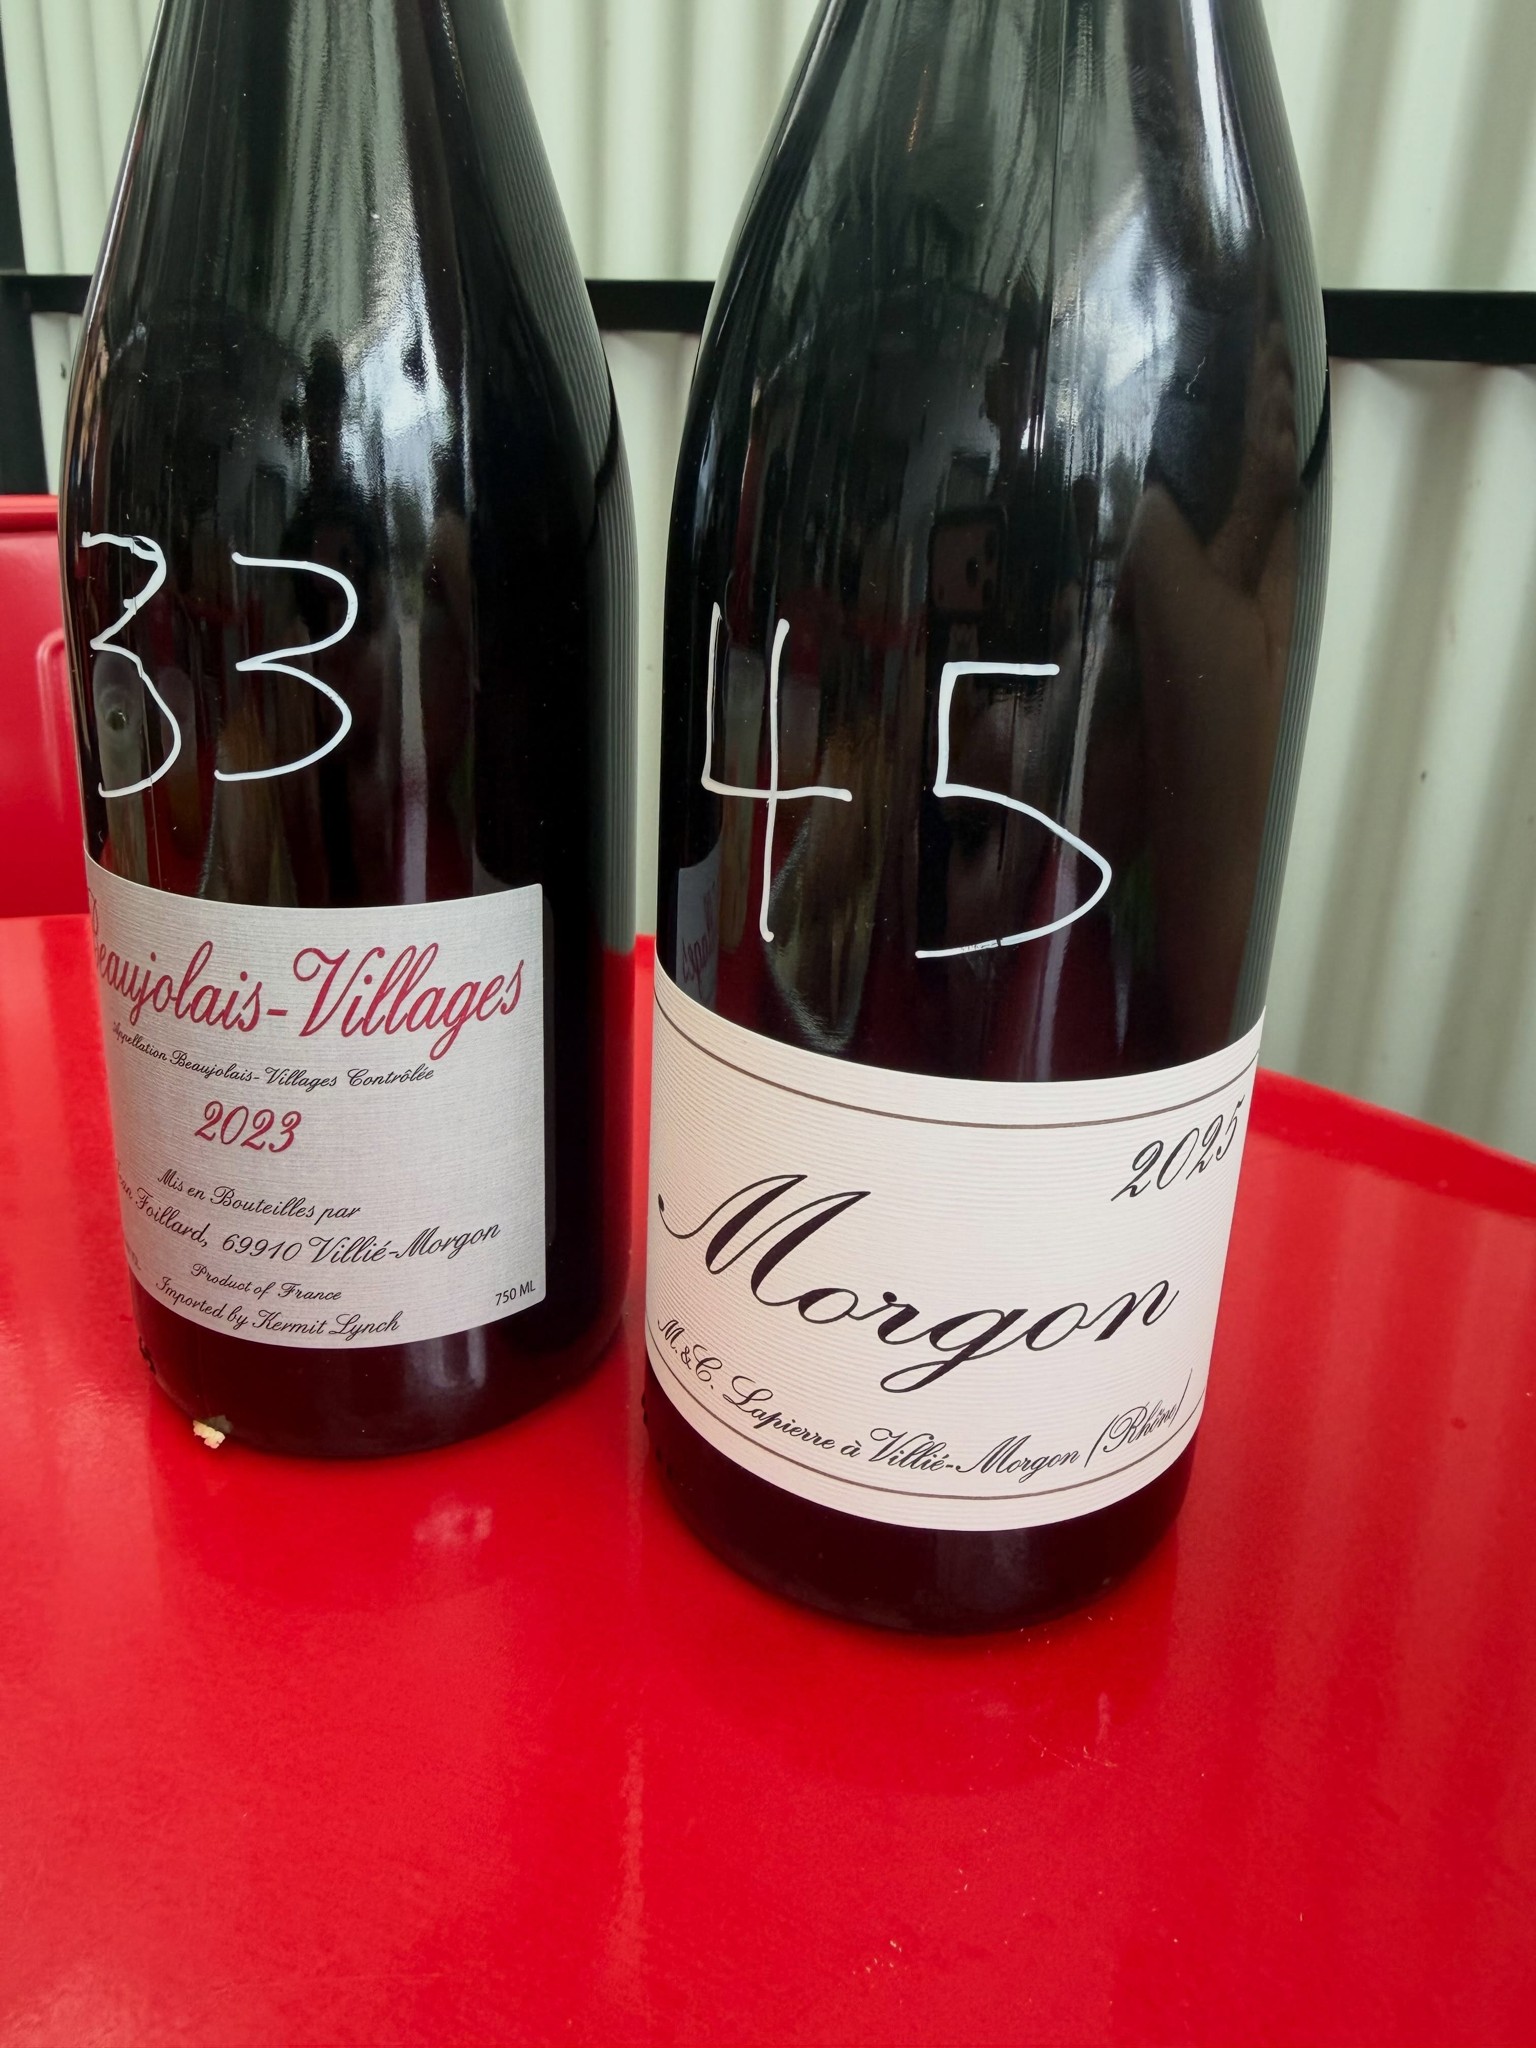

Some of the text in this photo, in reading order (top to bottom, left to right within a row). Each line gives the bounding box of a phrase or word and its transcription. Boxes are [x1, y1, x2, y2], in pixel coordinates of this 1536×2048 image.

[80, 532, 358, 797] 33
[701, 602, 1112, 959] 45
[195, 1100, 302, 1153] 2023
[1111, 1094, 1245, 1202] 2025
[135, 1187, 211, 1248] Foillard,
[222, 1233, 303, 1263] 69910
[308, 1223, 502, 1264] Villié-Morgon
[157, 1168, 361, 1225] Mis en Bouteilles par
[155, 1276, 402, 1341] Imported by Kermit Lynch
[190, 1263, 342, 1301] Product of France
[495, 1280, 536, 1307] 750 ML
[657, 1173, 1180, 1394] Morgon
[722, 1375, 836, 1451] Lapierre
[841, 1439, 861, 1459] à
[870, 1427, 1081, 1484] Villié-Morgon
